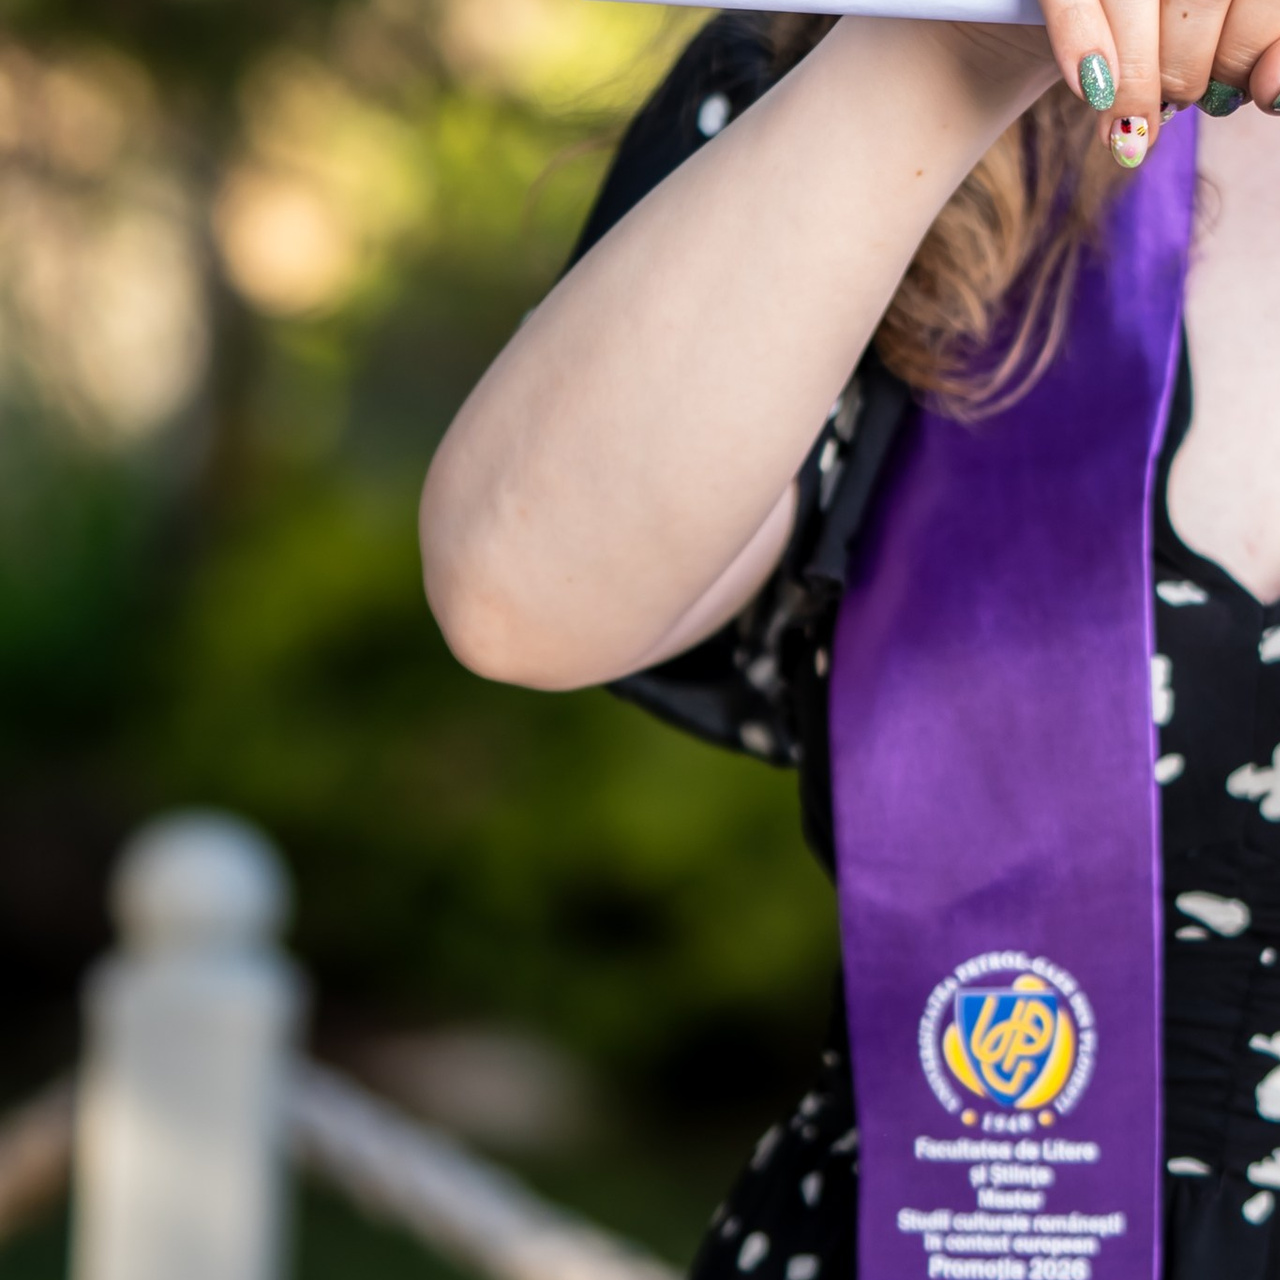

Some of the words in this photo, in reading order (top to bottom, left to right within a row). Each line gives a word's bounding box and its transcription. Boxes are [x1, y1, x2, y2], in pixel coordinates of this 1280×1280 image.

[915, 1136, 1012, 1160] Facultatea
[1014, 1139, 1040, 1161] de
[1042, 1138, 1099, 1162] Litere
[977, 1188, 1045, 1210] Master
[897, 1208, 952, 1231] Studii
[953, 1211, 1030, 1232] culturale
[945, 1234, 1011, 1253] context
[1013, 1236, 1100, 1256] european
